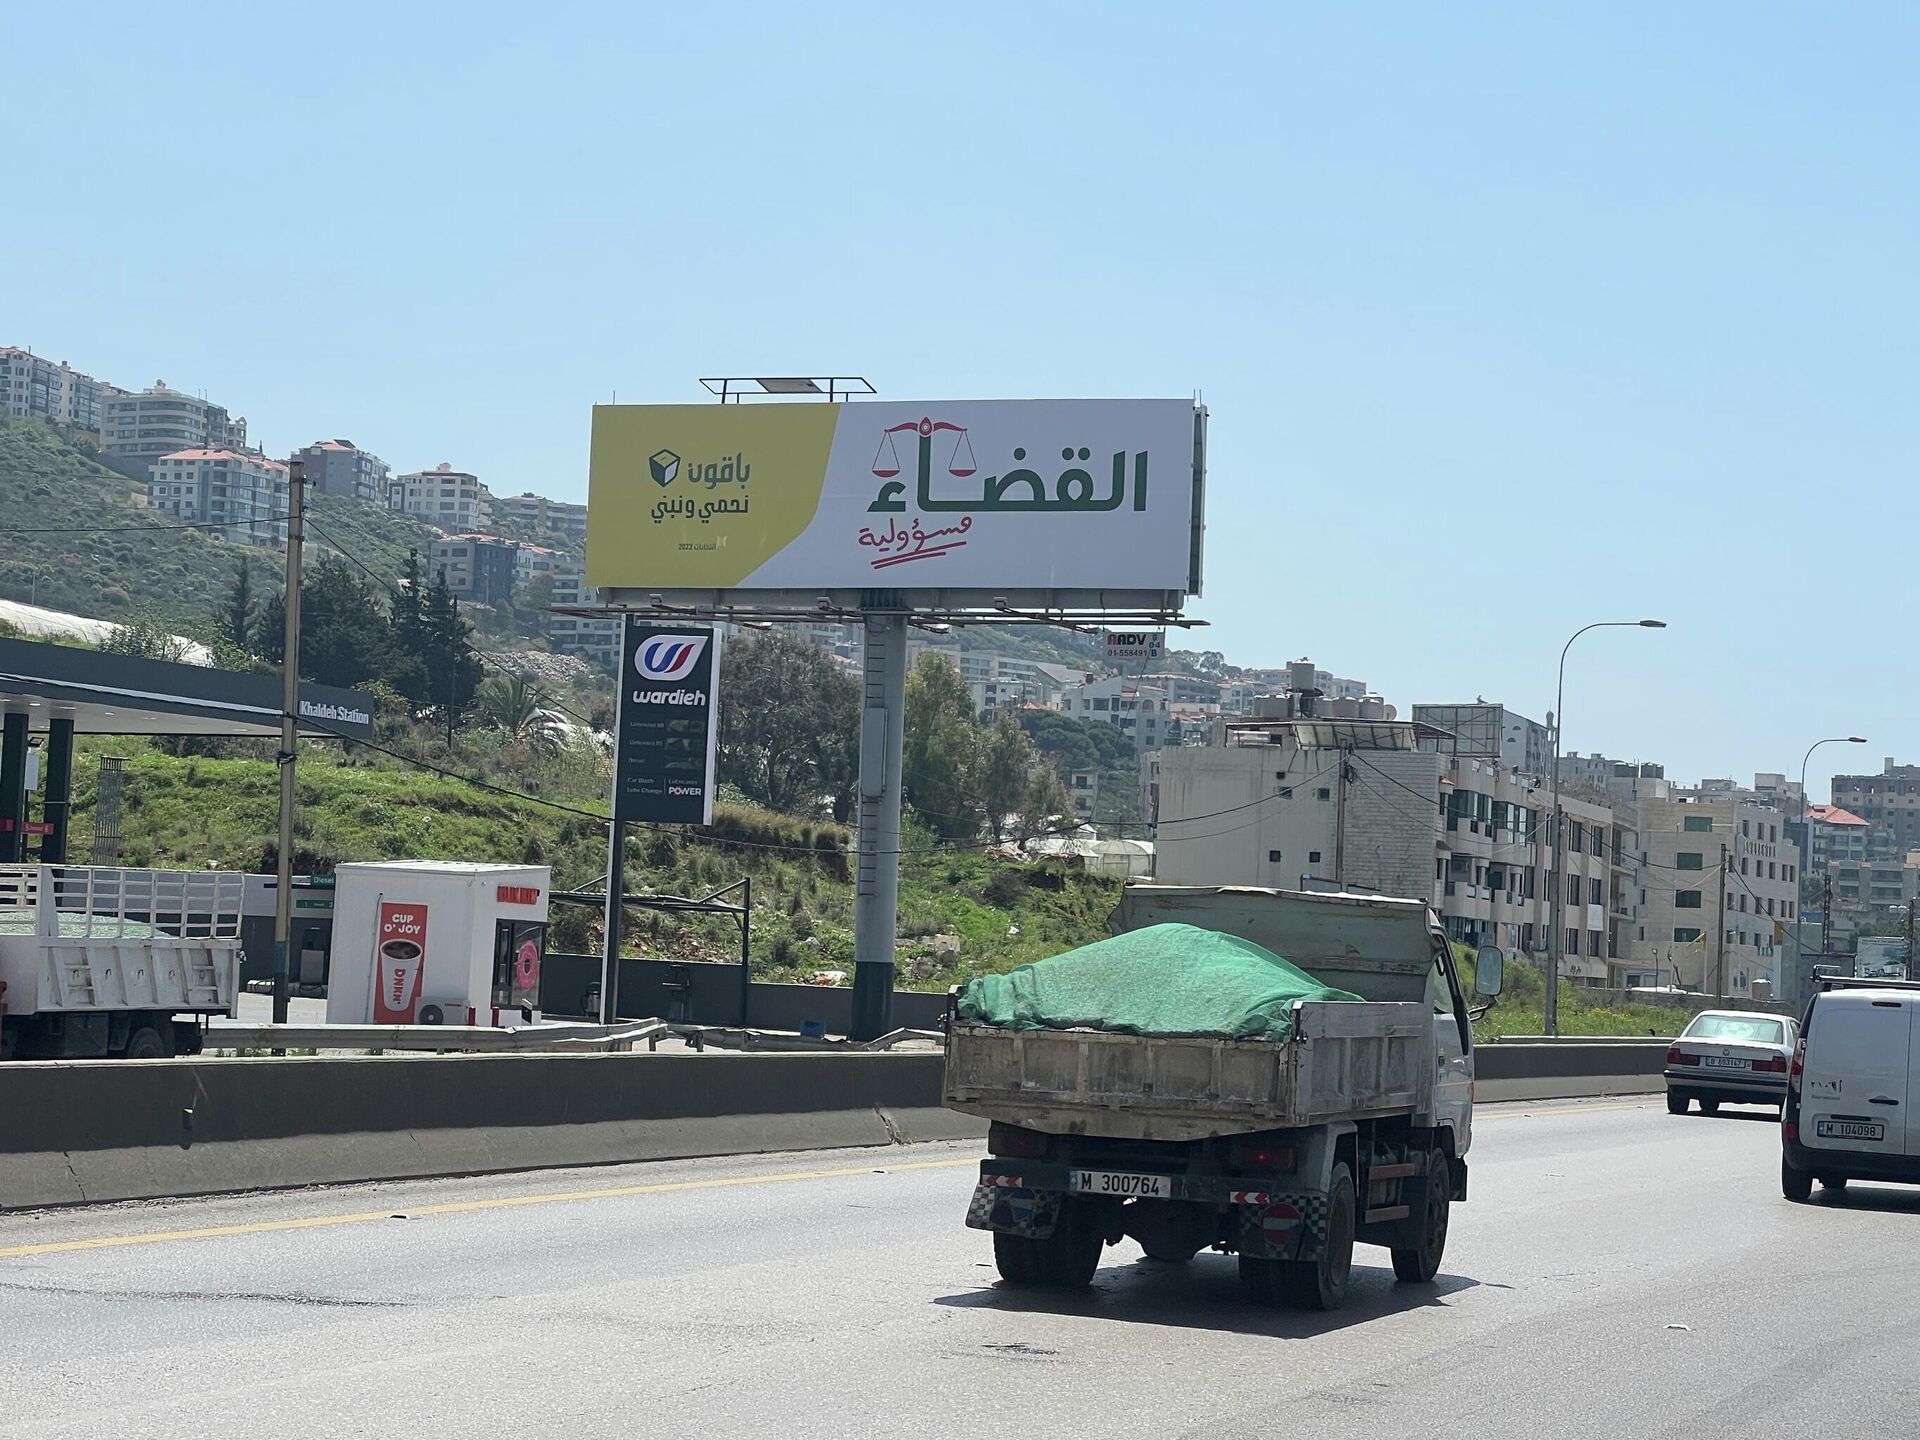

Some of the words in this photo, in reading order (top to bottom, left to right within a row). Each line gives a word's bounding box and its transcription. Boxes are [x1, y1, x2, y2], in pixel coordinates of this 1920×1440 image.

[688, 452, 750, 490] باقون
[867, 433, 1149, 512] القضاء
[698, 495, 749, 524] نحمي
[858, 516, 973, 553] مسؤولية
[1151, 649, 1157, 657] B
[632, 689, 706, 706] wardieh
[300, 700, 337, 720] Khaldeh
[336, 706, 370, 725] Station
[668, 786, 702, 796] POWER
[391, 913, 414, 924] CUP
[398, 924, 421, 935] JOY
[1826, 1123, 1834, 1134] M
[1840, 1124, 1876, 1137] 104098
[1080, 1172, 1092, 1190] M
[1101, 1174, 1160, 1196] 300764
